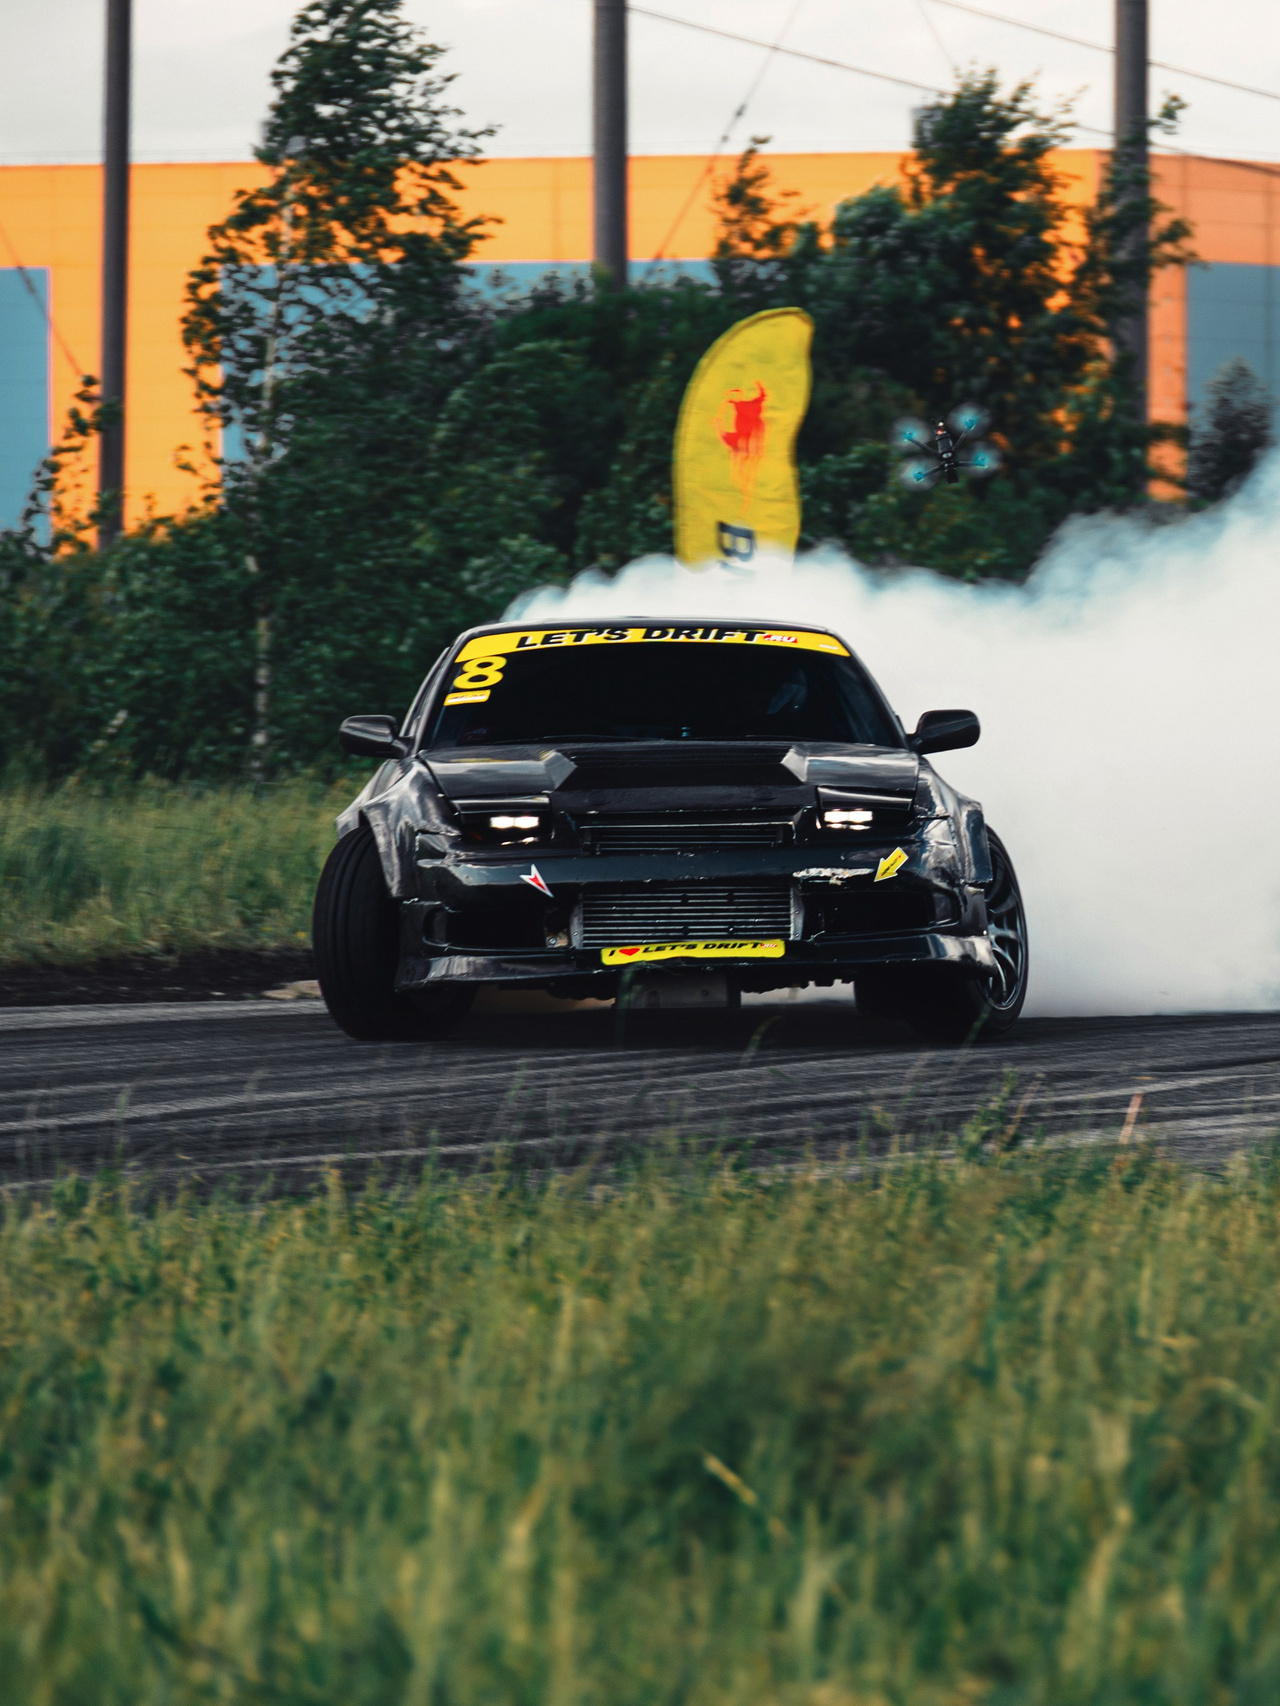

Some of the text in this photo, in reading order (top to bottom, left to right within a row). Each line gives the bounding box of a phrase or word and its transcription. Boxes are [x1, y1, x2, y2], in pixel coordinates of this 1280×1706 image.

[516, 628, 631, 649] LET'S
[453, 655, 507, 690] 8
[642, 943, 698, 954] LET'S
